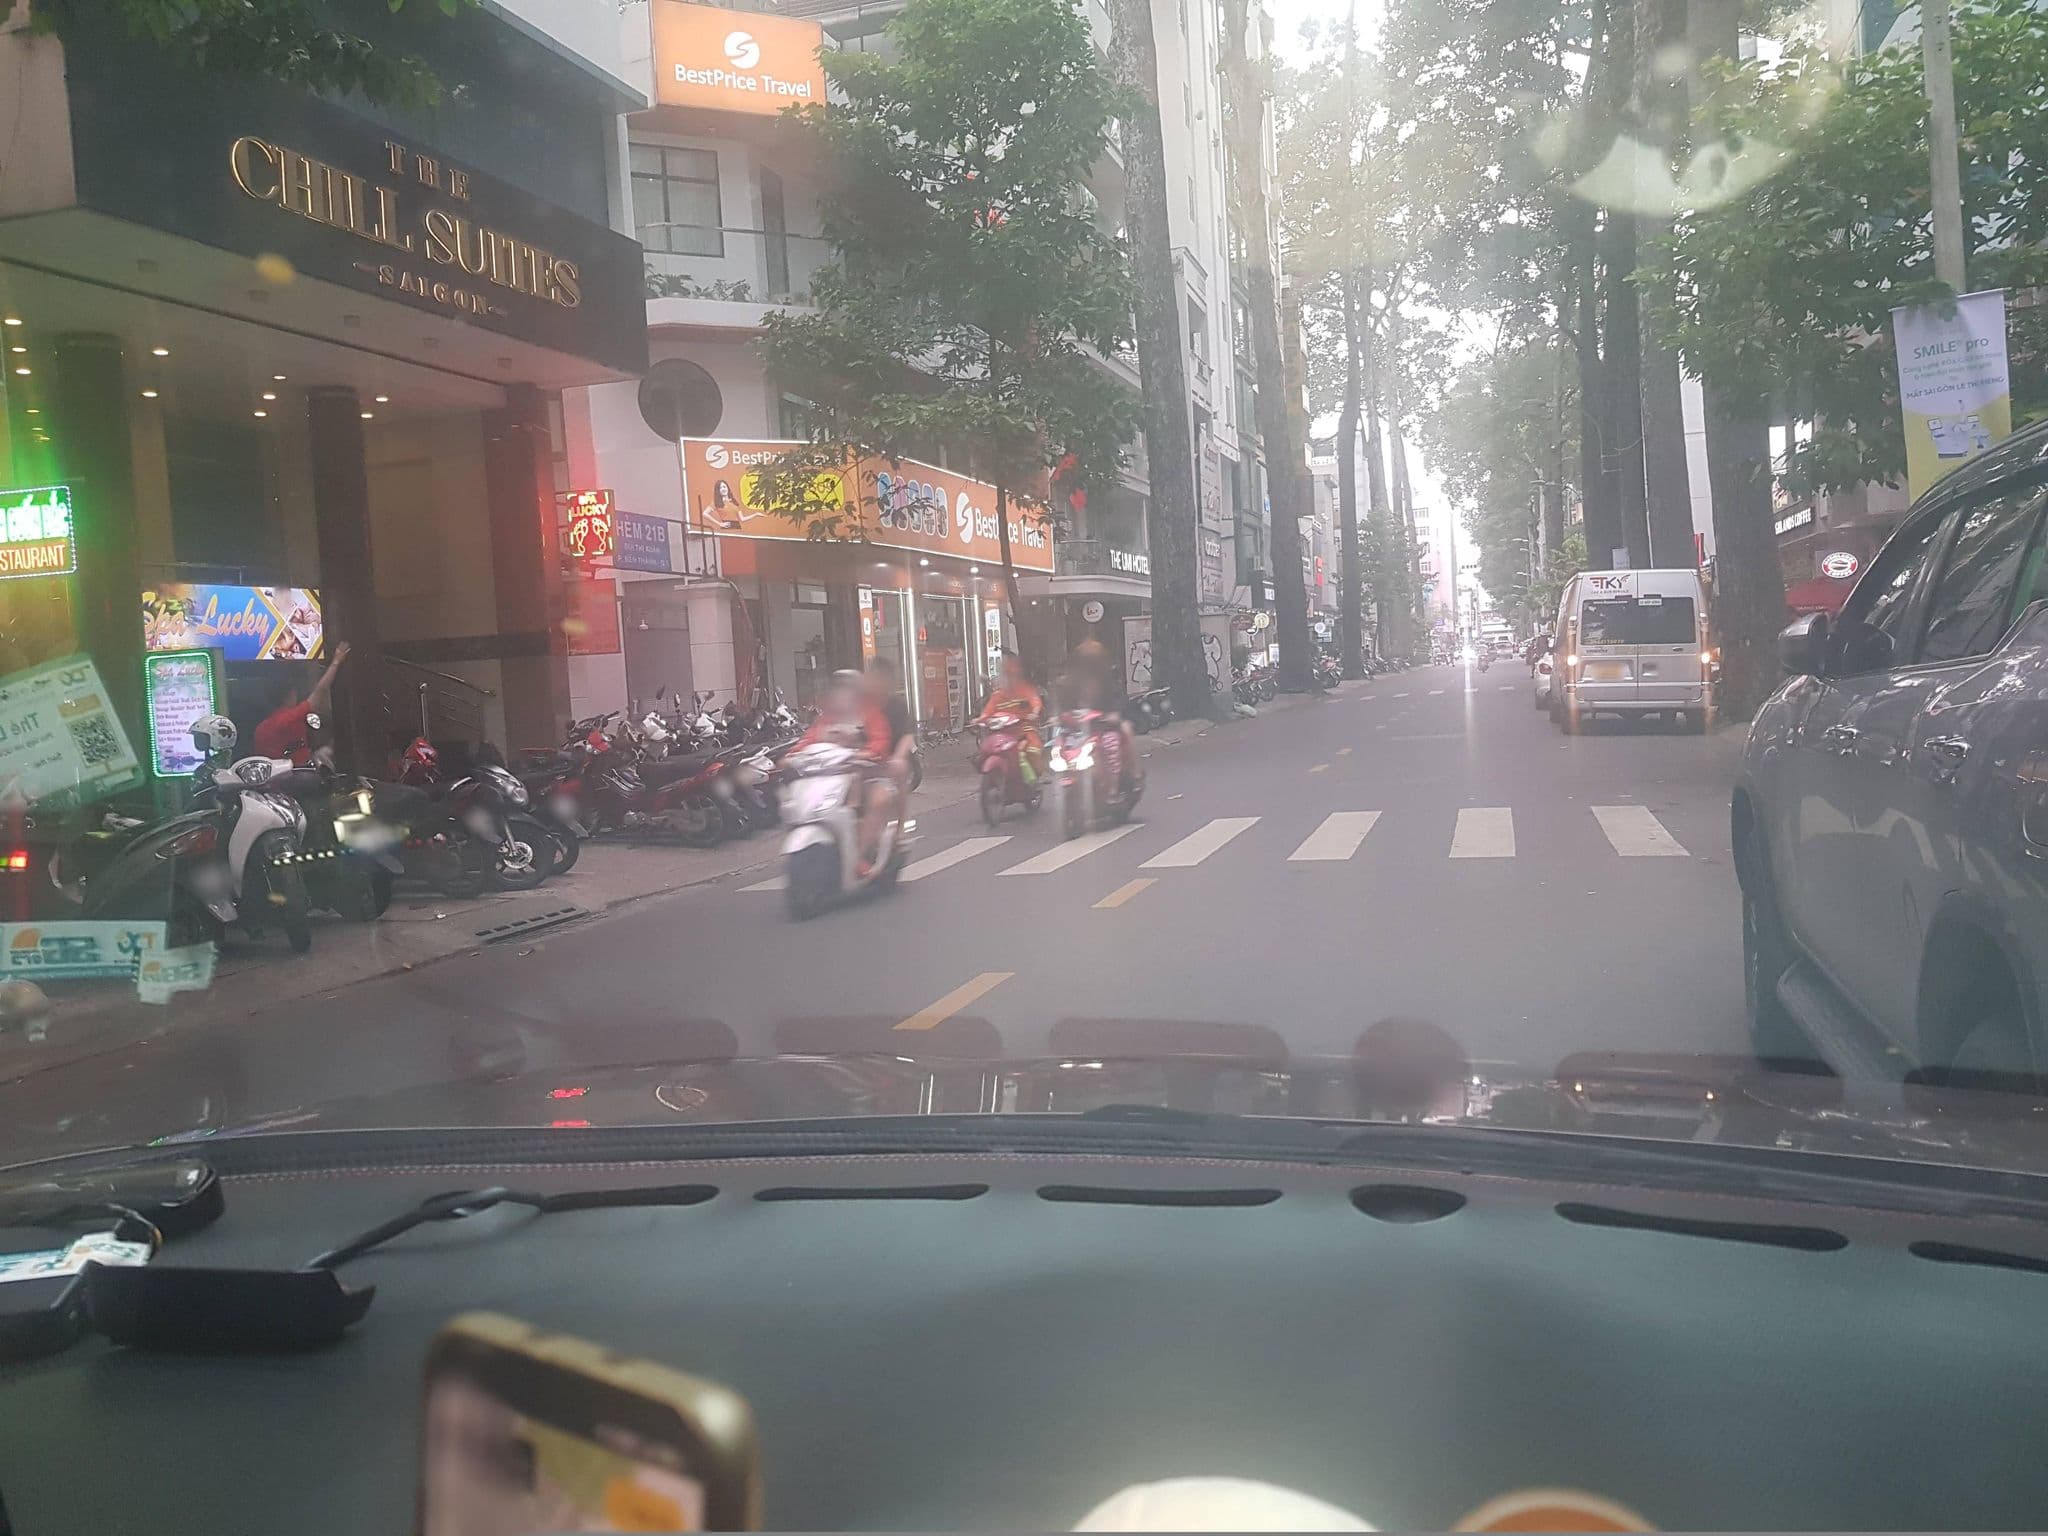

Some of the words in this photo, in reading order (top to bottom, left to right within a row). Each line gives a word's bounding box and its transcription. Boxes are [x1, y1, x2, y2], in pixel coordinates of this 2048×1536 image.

[675, 64, 757, 91] BestPrice
[761, 75, 811, 97] Travel
[384, 140, 471, 201] THE
[231, 136, 413, 252] CHILL
[425, 209, 581, 308] SUITES
[378, 264, 489, 315] SAIGON
[1913, 341, 1957, 360] SMILE
[1966, 338, 1989, 352] pro
[571, 503, 608, 518] LUCKY
[1795, 507, 1812, 529] COFFEE
[645, 524, 665, 542] 21B
[1110, 549, 1122, 570] THE
[1133, 554, 1151, 576] HOTEL
[196, 593, 269, 647] Lucky
